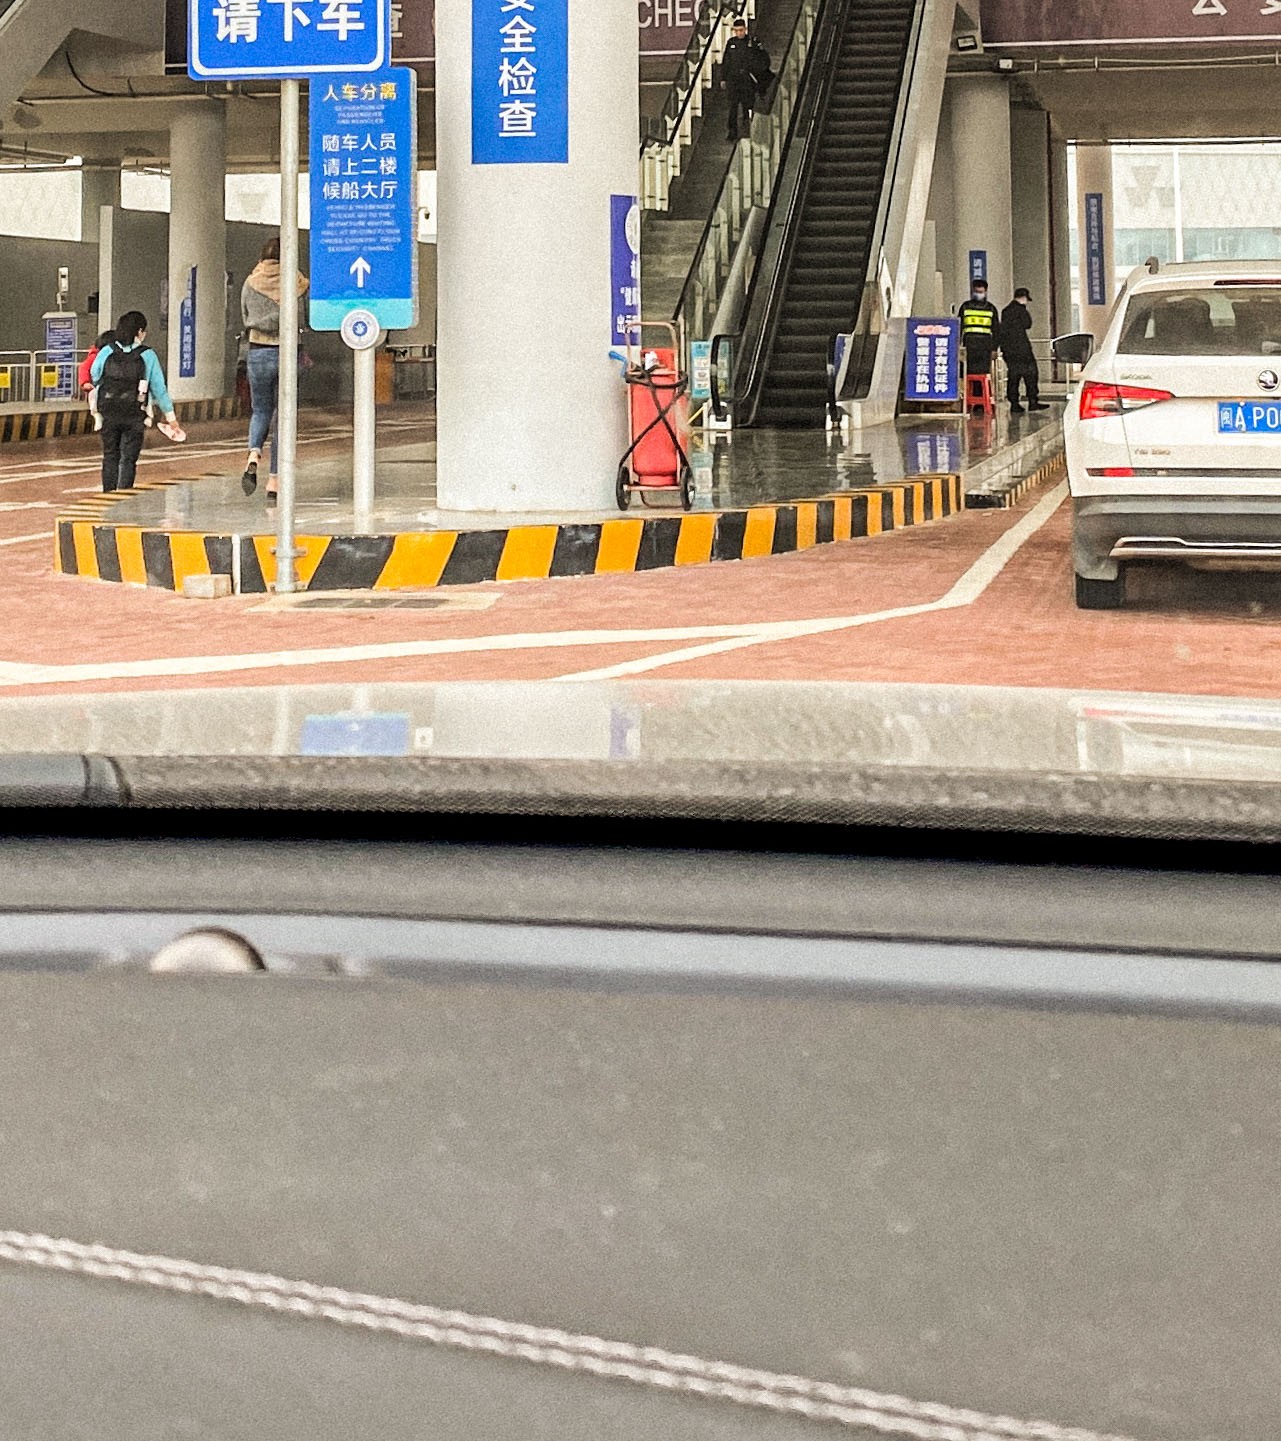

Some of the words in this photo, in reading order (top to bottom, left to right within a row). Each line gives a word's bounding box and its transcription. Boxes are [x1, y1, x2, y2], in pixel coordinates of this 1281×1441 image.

[322, 82, 398, 102] 人车分离
[322, 132, 398, 153] 随车人员
[322, 156, 398, 177] 请上二楼
[322, 180, 399, 201] 候船大厅
